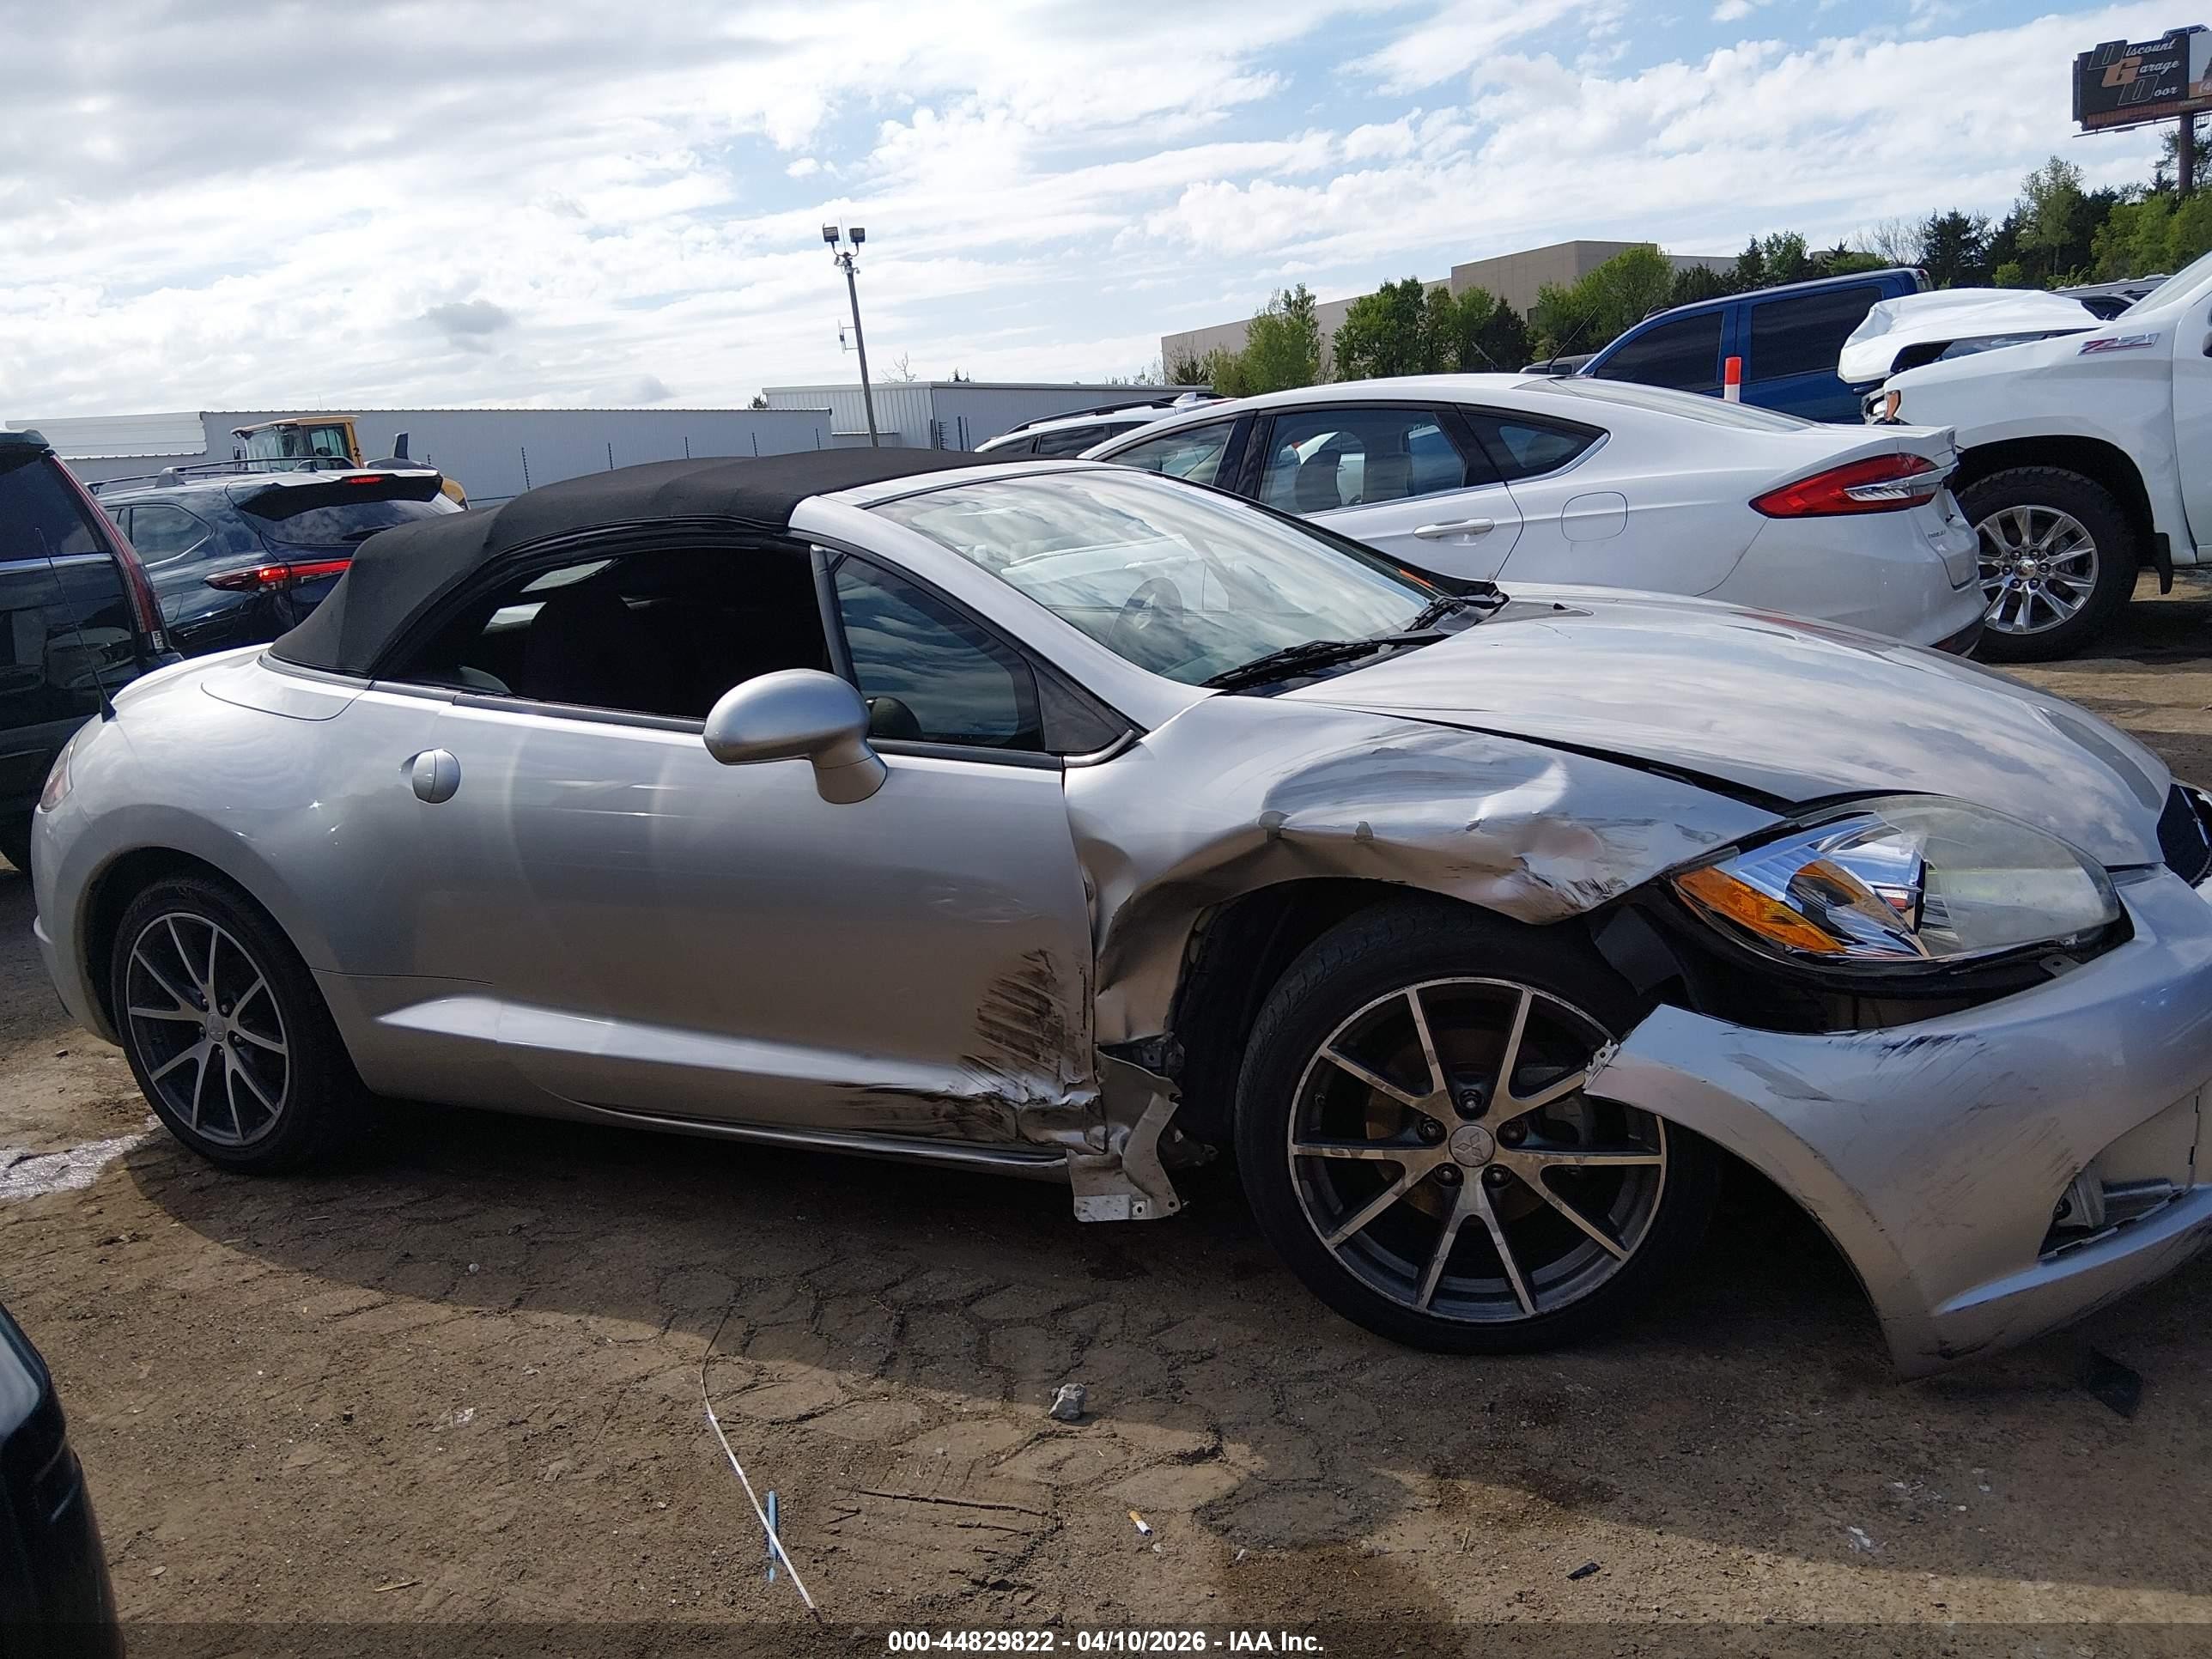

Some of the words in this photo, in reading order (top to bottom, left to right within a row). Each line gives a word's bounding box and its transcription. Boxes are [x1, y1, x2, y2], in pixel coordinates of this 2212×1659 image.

[2087, 39, 2177, 70] Discount
[2102, 56, 2179, 88] Garage
[2118, 74, 2179, 106] Door
